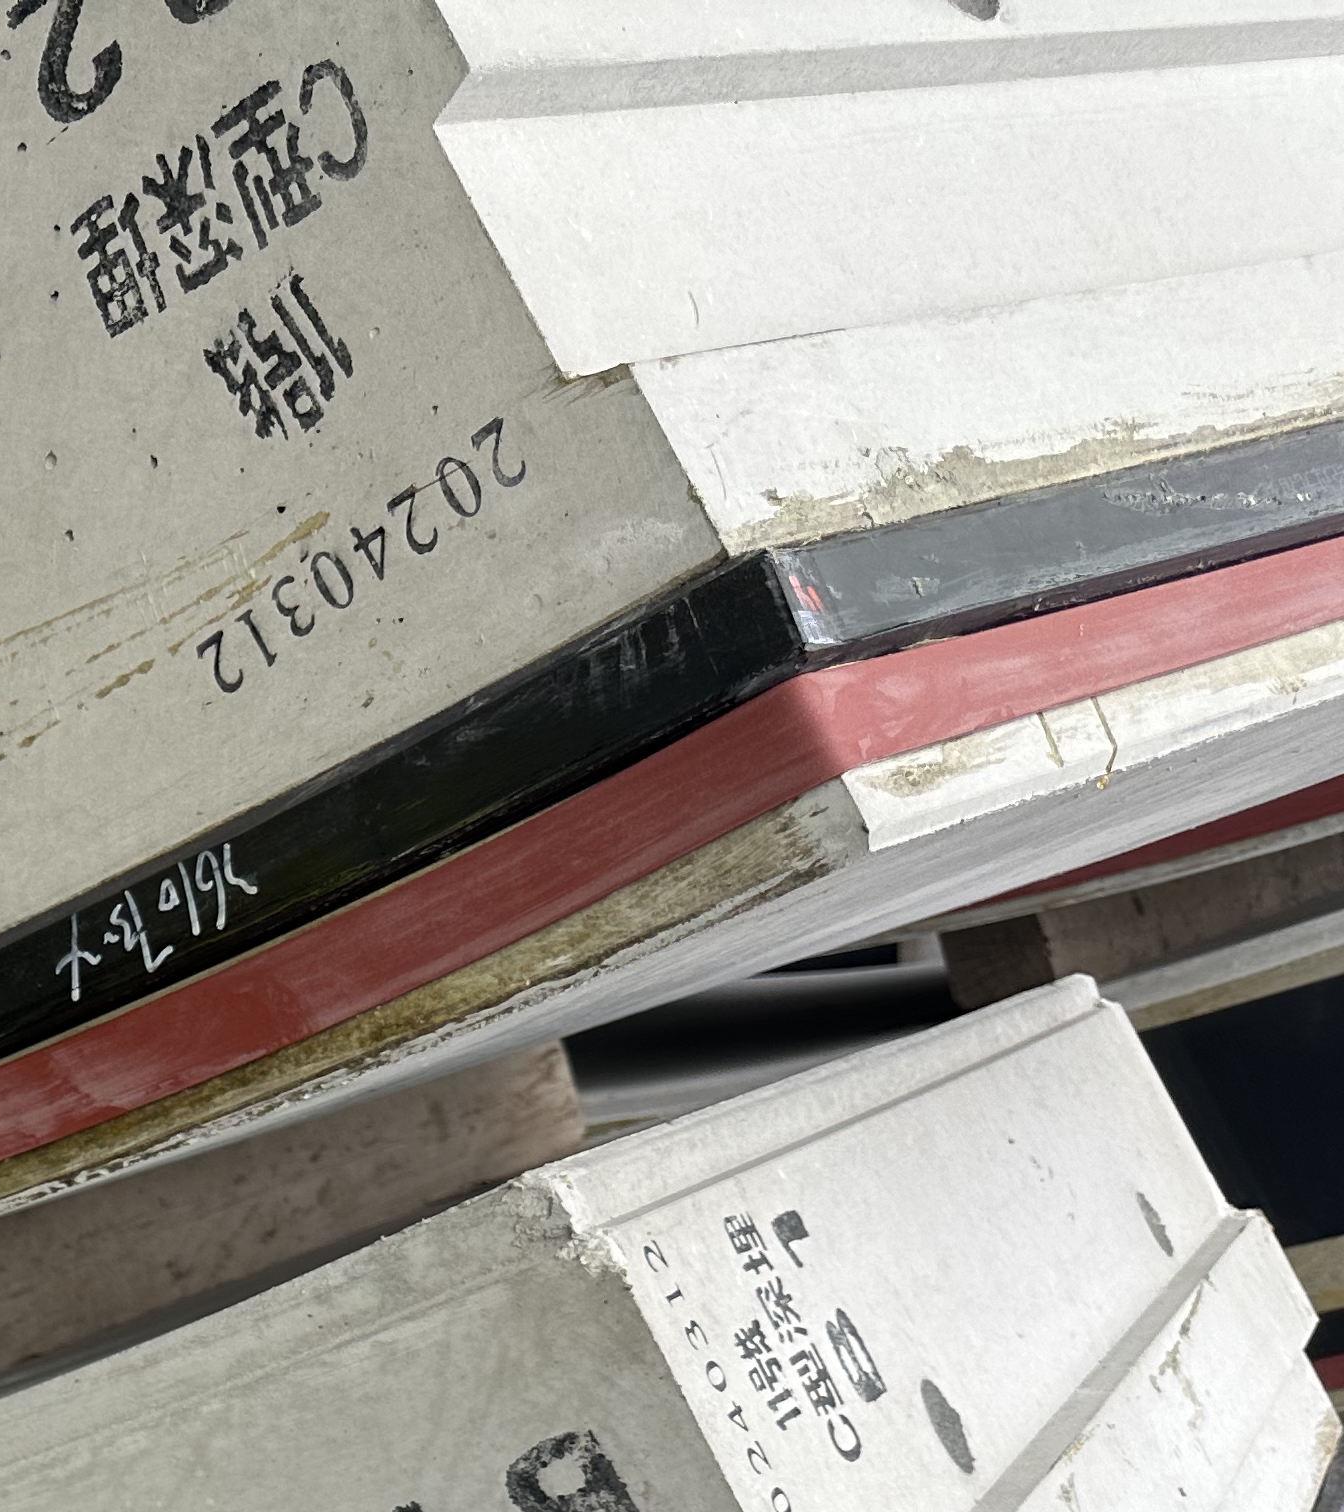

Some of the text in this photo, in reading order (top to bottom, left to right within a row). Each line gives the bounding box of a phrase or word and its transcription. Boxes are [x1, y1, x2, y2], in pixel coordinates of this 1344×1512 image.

[67, 58, 368, 340] C型深埋
[194, 416, 526, 695] 20240312
[722, 1210, 863, 1466] C型深埋
[729, 1317, 803, 1434] 11号线
